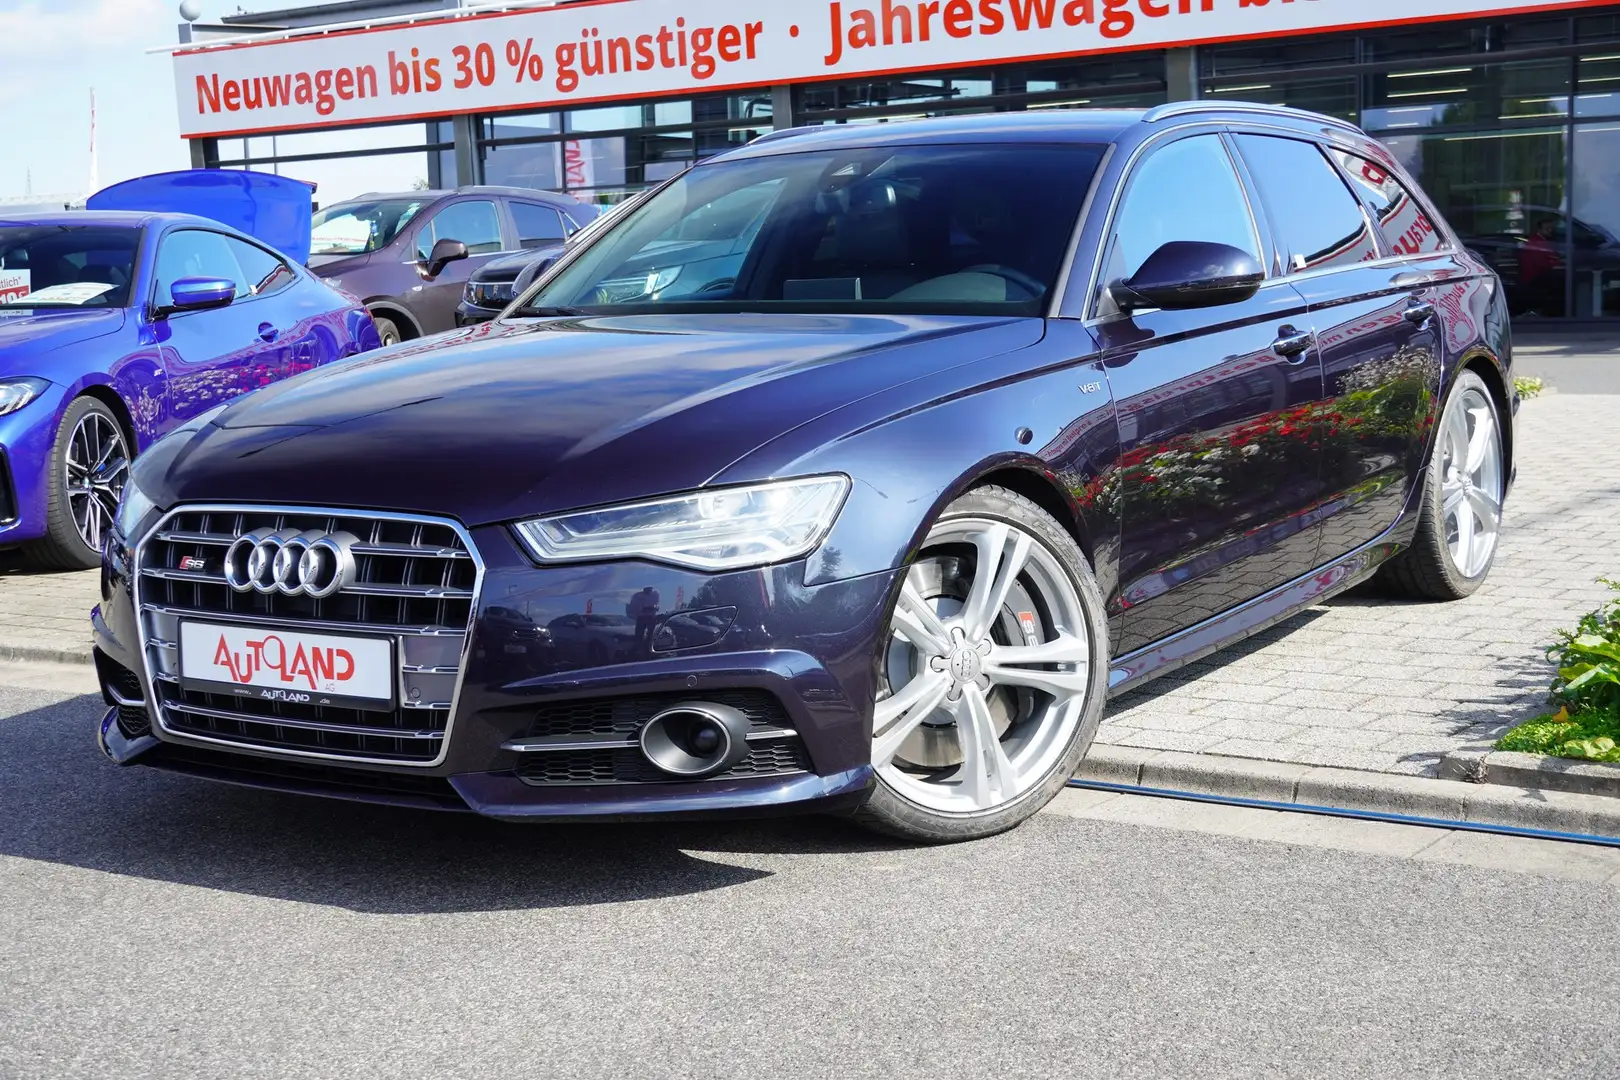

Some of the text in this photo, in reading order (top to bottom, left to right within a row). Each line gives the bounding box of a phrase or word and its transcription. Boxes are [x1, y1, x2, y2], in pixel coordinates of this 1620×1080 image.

[196, 66, 377, 116] Neuwagen
[388, 47, 442, 95] bis
[453, 42, 496, 89] 30
[506, 38, 544, 83] %
[555, 17, 763, 93] günstiger
[1078, 381, 1101, 394] V8T
